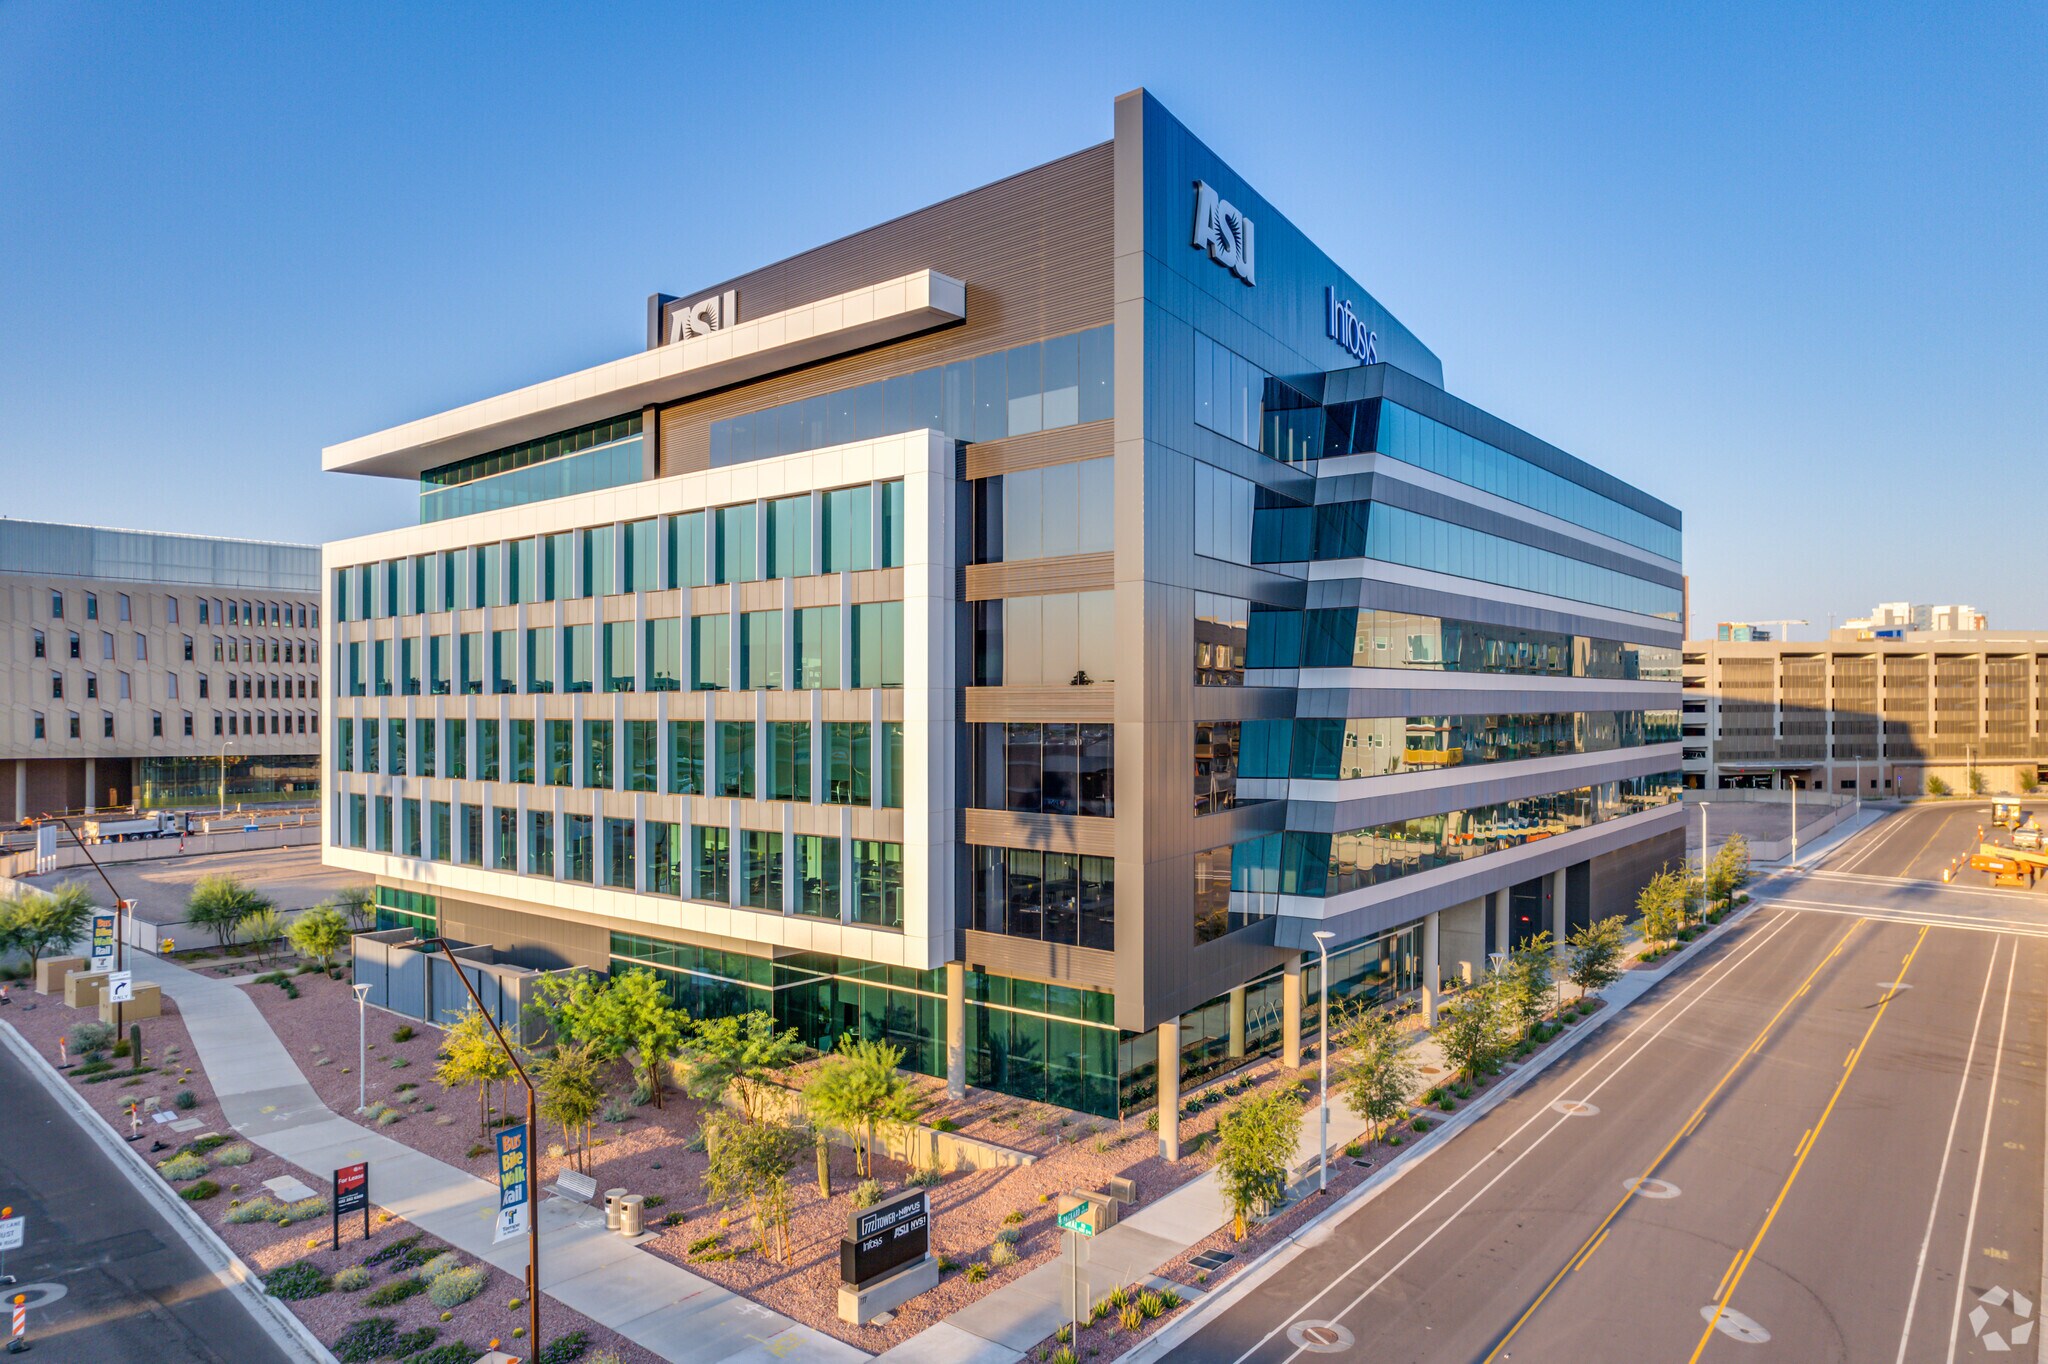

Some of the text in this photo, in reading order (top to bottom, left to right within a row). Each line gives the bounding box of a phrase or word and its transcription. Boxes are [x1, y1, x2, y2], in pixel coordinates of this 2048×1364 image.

[1193, 179, 1256, 287] ASU
[1328, 285, 1378, 365] Infosys
[97, 918, 112, 928] Bus
[95, 927, 113, 937] Bike
[93, 936, 113, 947] Walk
[95, 945, 111, 956] Rail
[502, 1134, 522, 1153] Bus
[502, 1151, 524, 1172] Bike
[348, 1174, 364, 1182] Lease
[501, 1166, 526, 1190] Walk
[877, 1212, 896, 1229] TOWER
[1062, 1207, 1081, 1223] PACKARD
[0, 1230, 14, 1238] UST
[894, 1222, 910, 1239] ASU
[863, 1237, 883, 1252] Infosys
